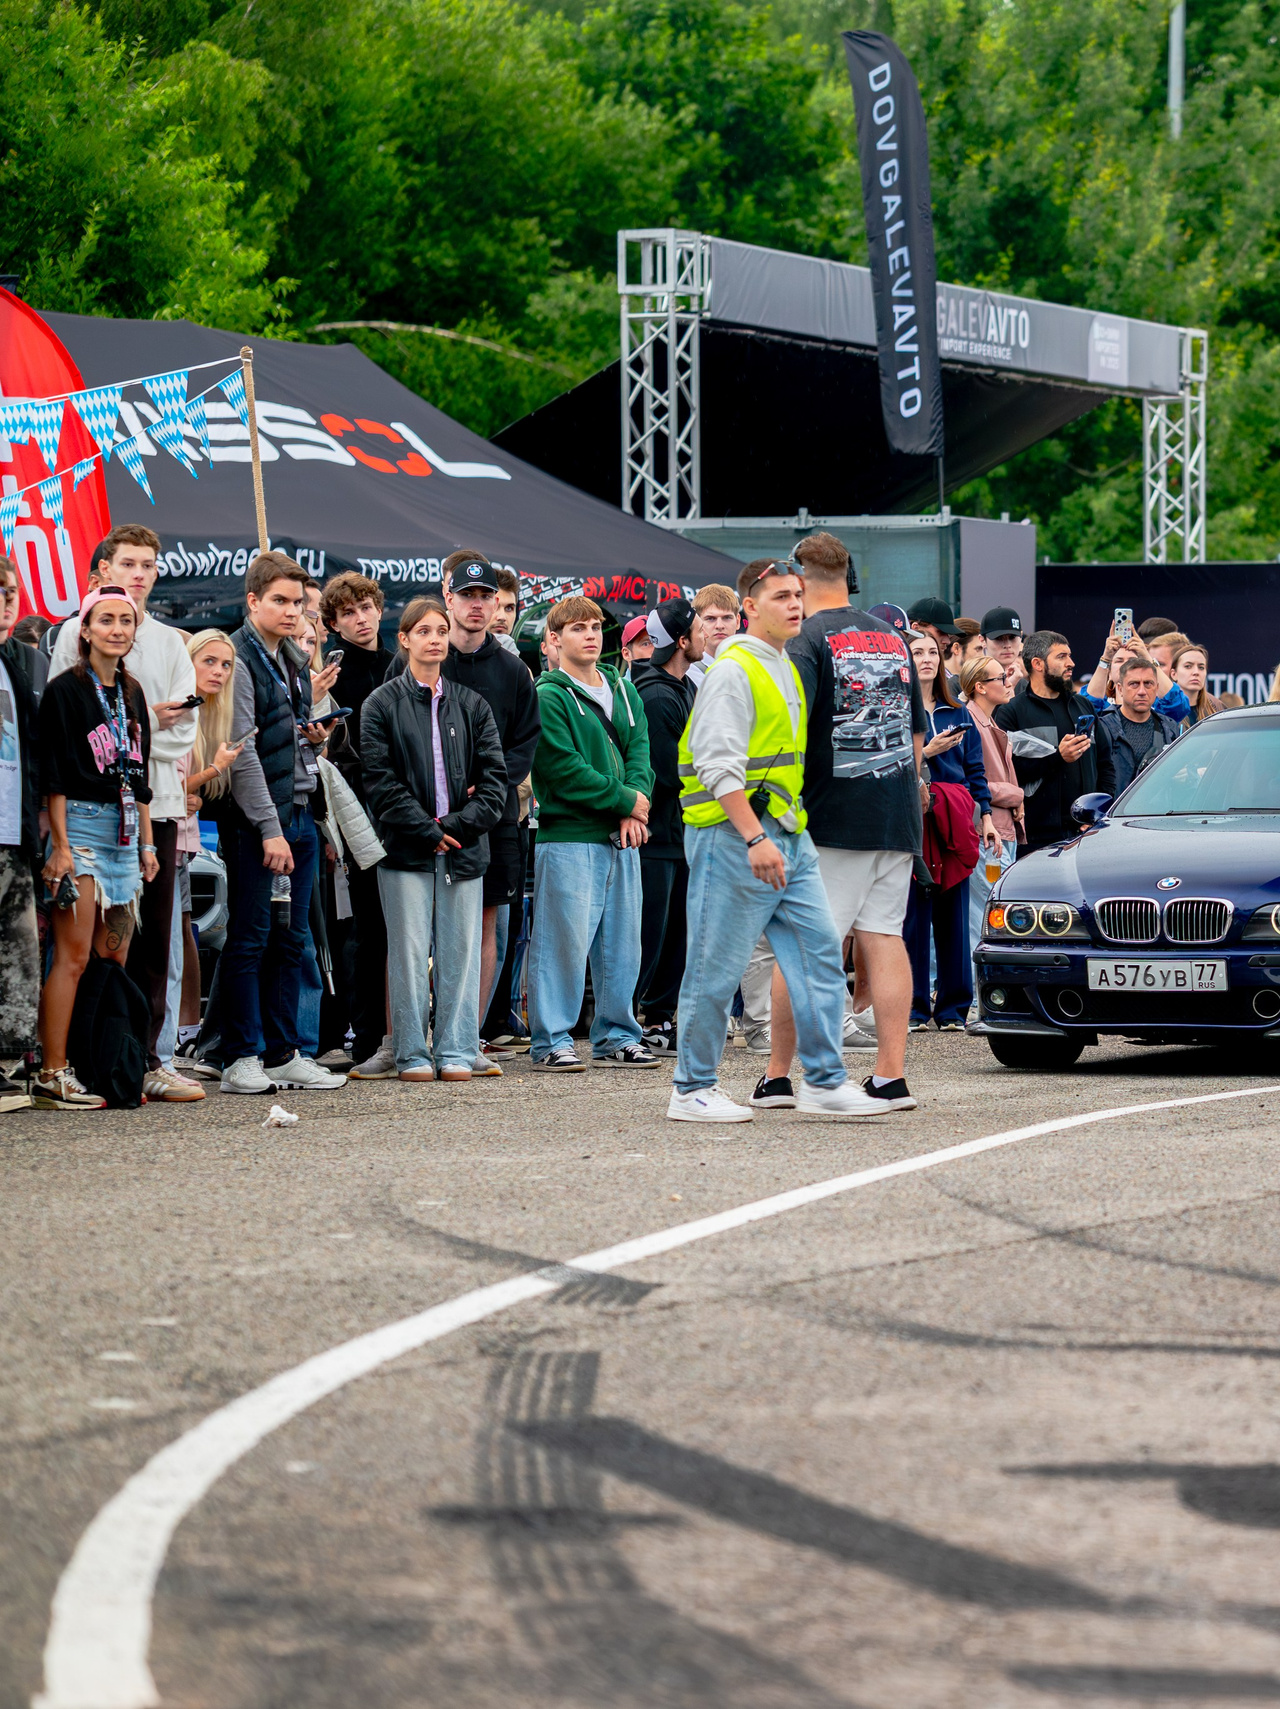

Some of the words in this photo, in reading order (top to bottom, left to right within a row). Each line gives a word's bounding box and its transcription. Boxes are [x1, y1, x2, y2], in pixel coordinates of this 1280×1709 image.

[868, 61, 922, 419] DOVGALEVAVTO
[840, 651, 865, 661] Nothing
[877, 652, 891, 660] Come
[1194, 963, 1217, 981] 77
[1198, 981, 1216, 989] RUS
